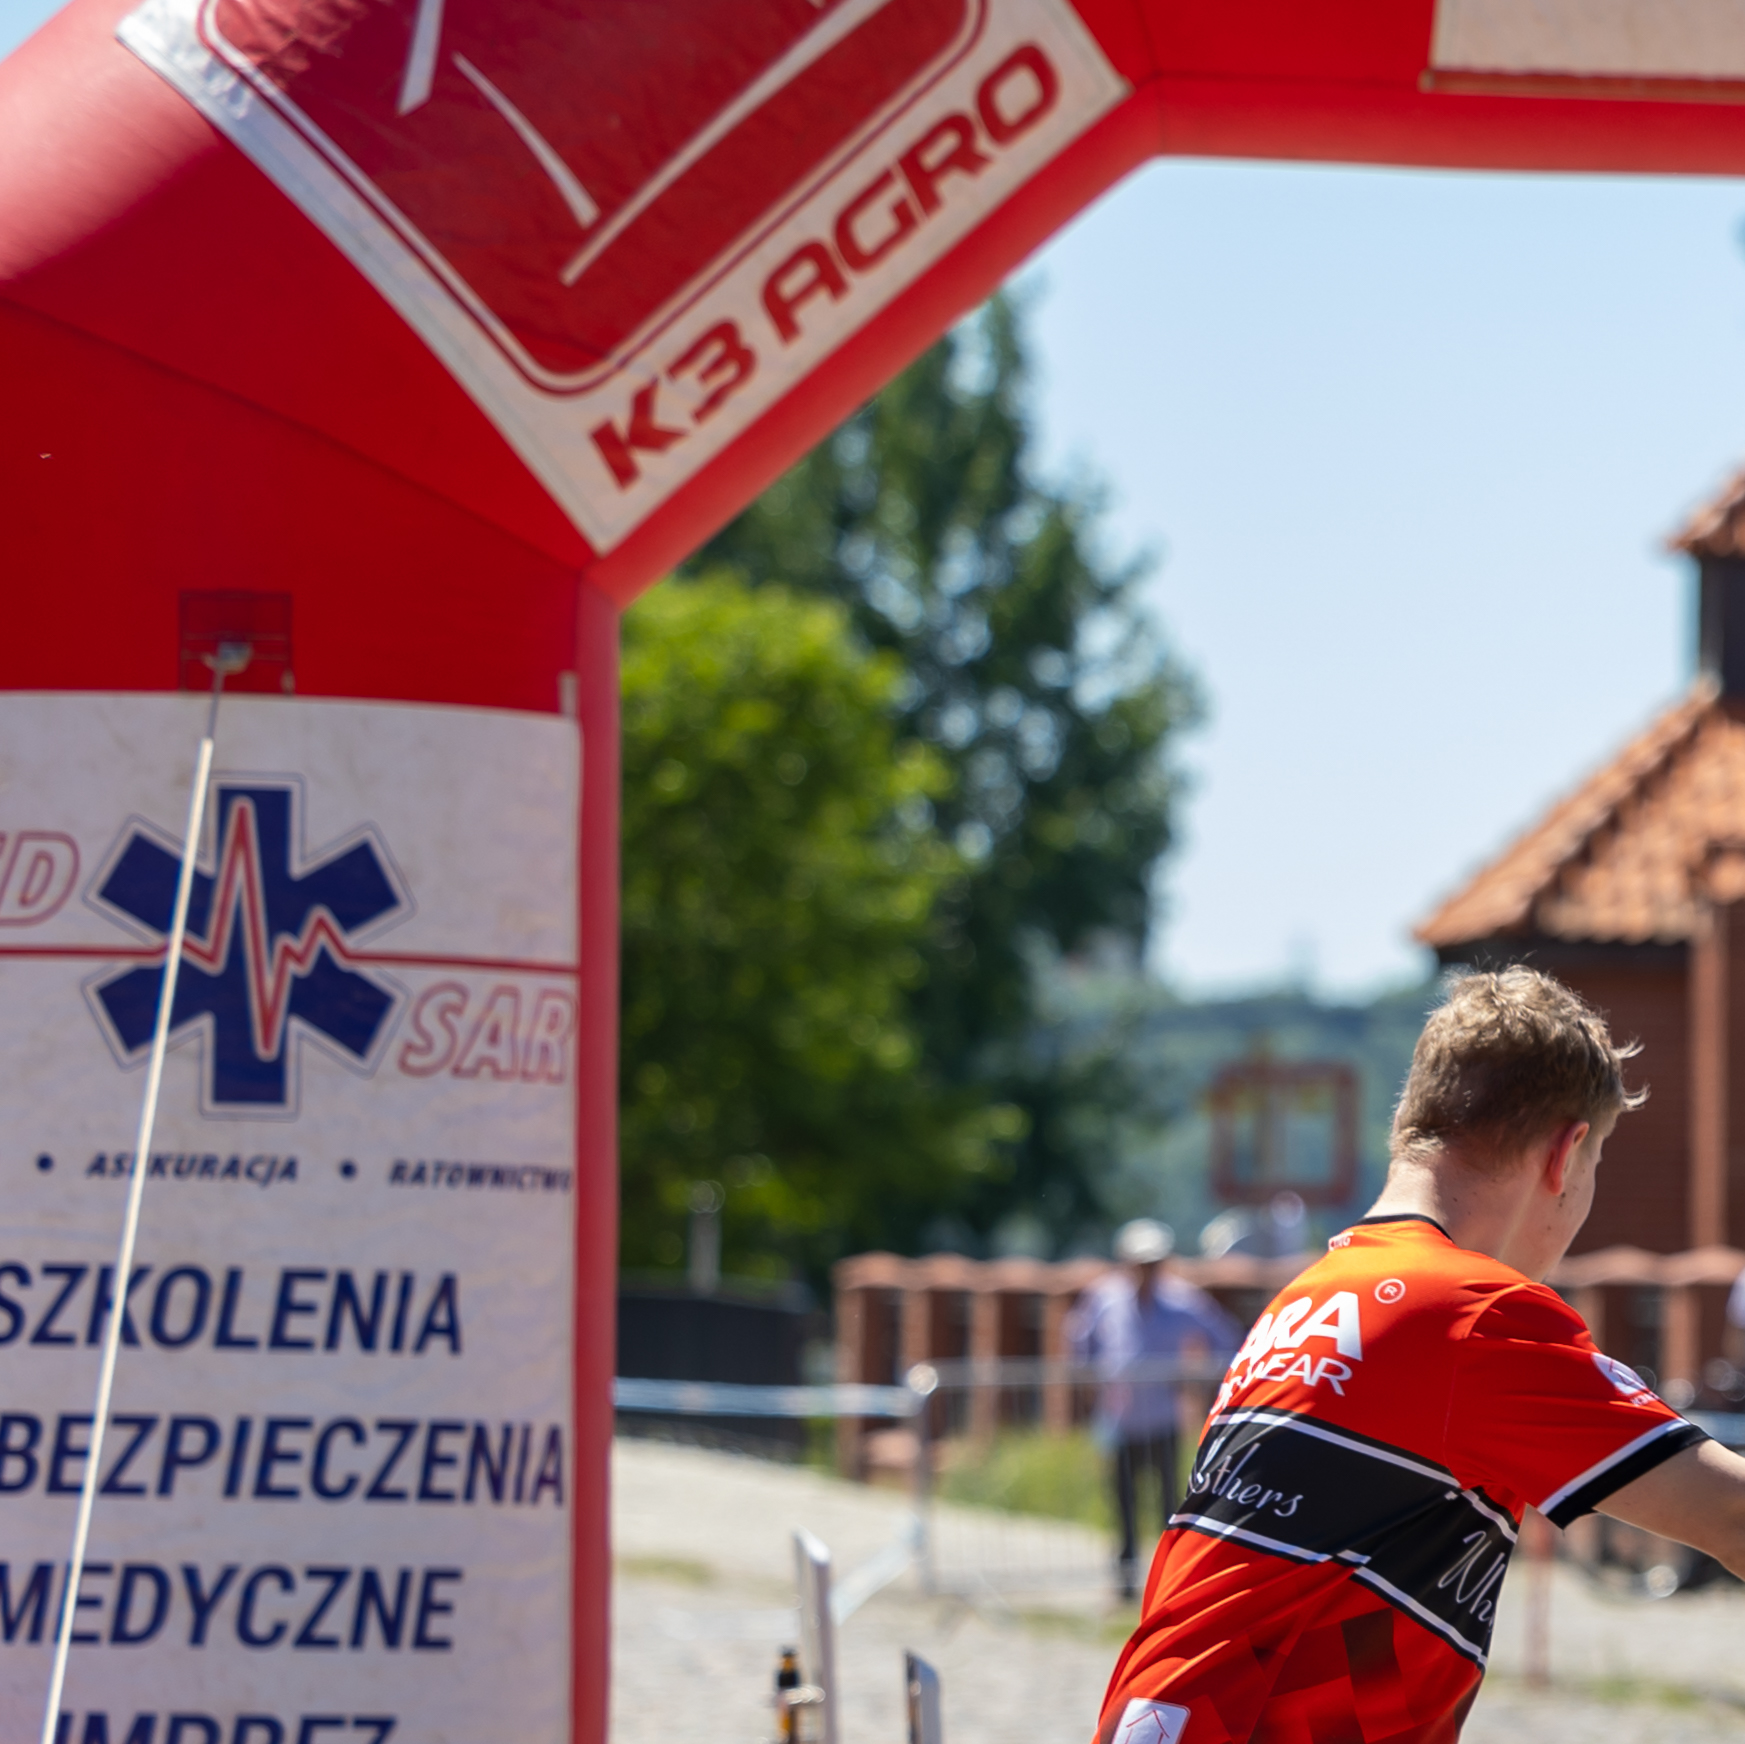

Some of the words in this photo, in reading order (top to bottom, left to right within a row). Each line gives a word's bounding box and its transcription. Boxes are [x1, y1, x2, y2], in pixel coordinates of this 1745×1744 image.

[588, 316, 759, 491] K3
[755, 42, 1062, 346] AGRO
[398, 981, 575, 1085] SAR
[0, 1261, 464, 1357] SZKOLENIA
[0, 1413, 567, 1509] BEZPIECZENIA
[0, 1562, 465, 1652] MEDYCZNE
